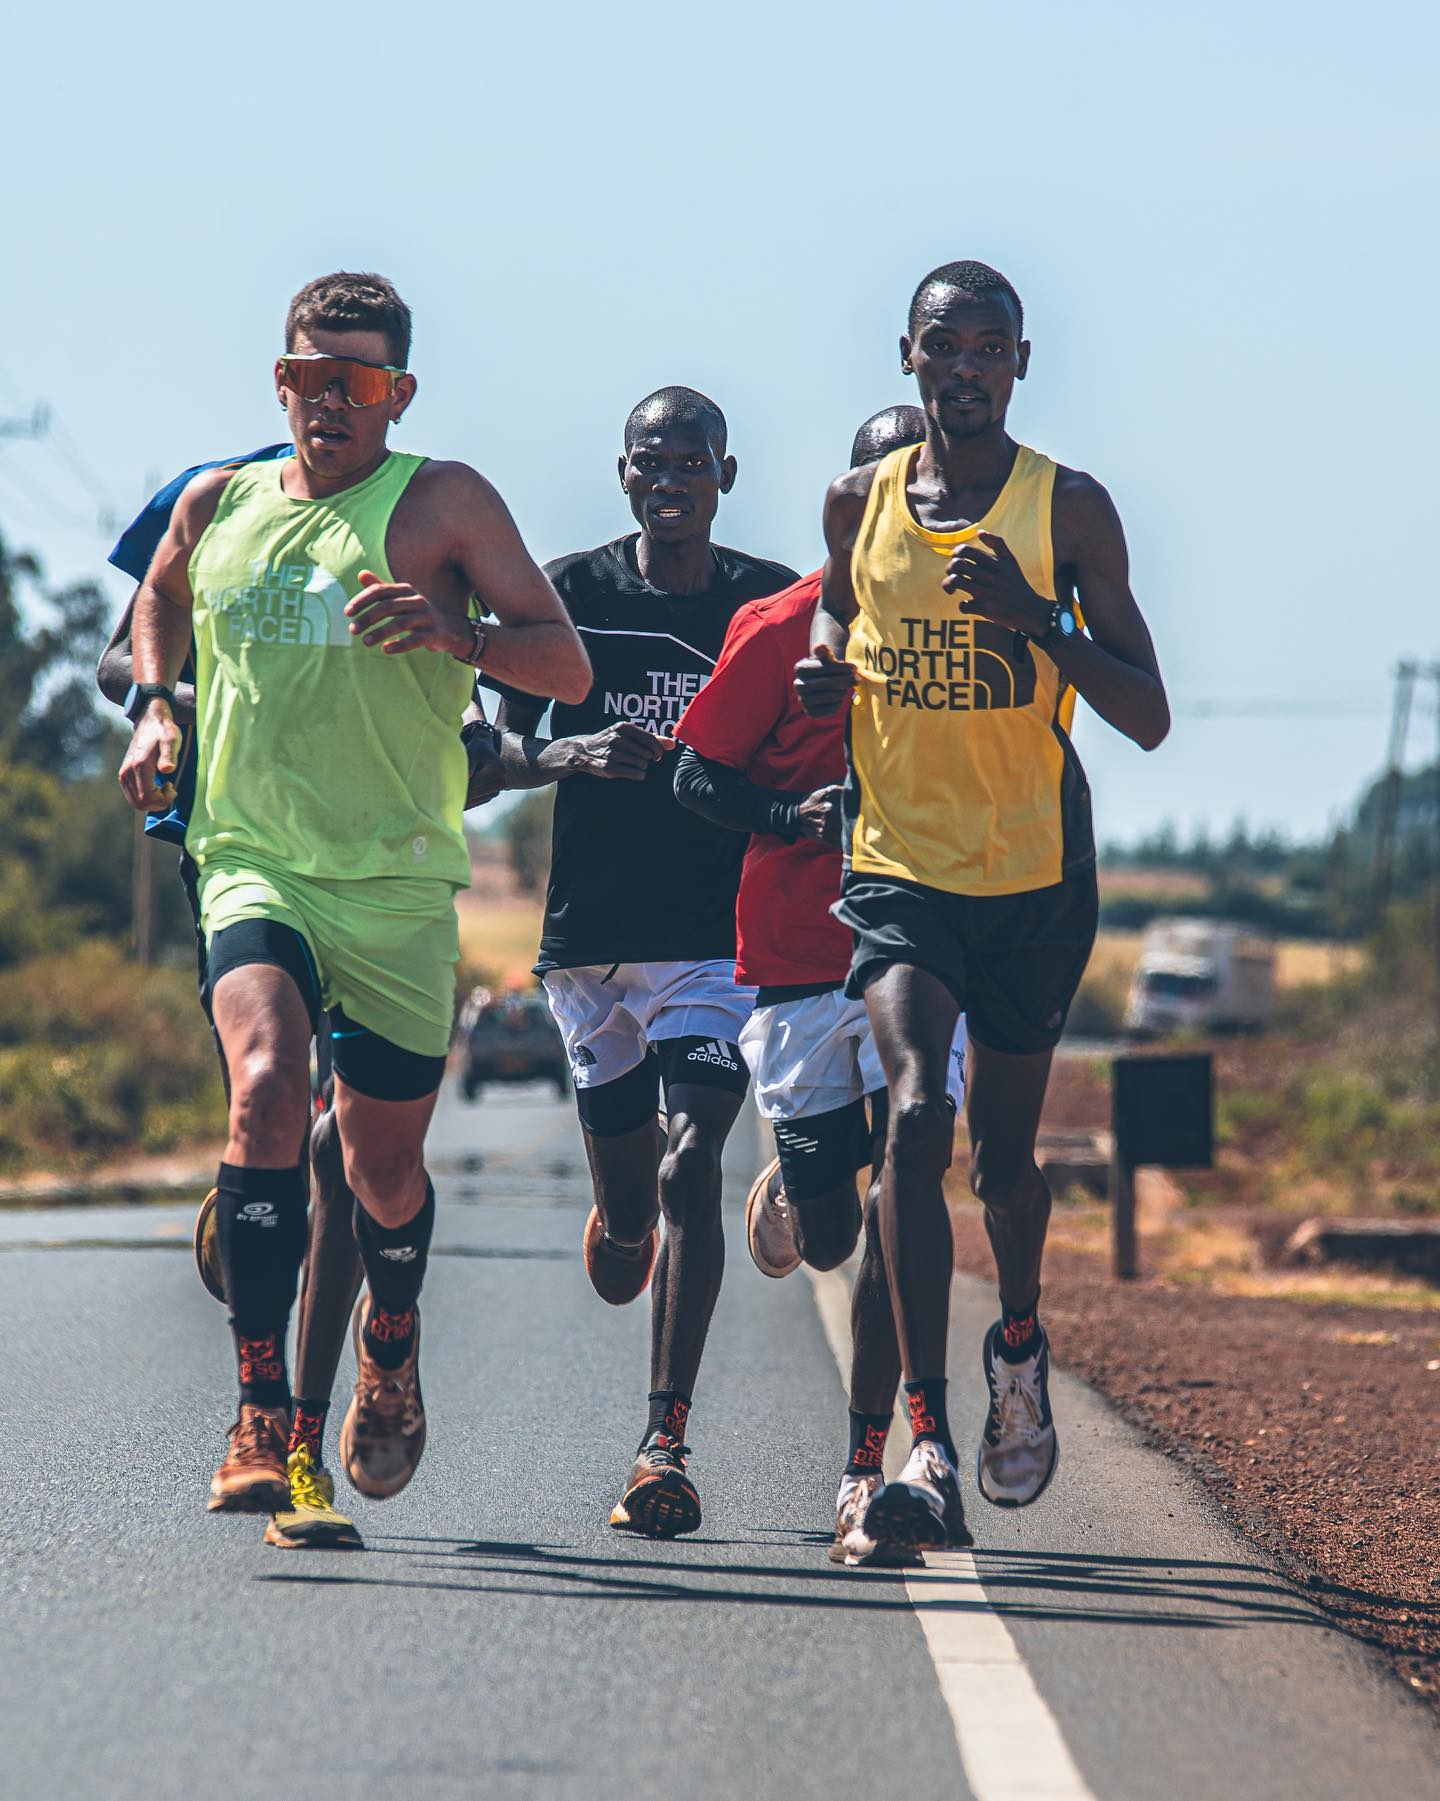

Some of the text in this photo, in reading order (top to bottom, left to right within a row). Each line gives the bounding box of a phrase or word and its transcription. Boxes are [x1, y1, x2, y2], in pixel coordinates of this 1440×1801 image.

[250, 560, 304, 589] HE
[229, 616, 297, 644] FACE
[901, 618, 970, 650] THE
[864, 643, 970, 680] NORTH
[646, 671, 699, 697] THE
[886, 679, 970, 711] FACE
[687, 1052, 739, 1071] adidas
